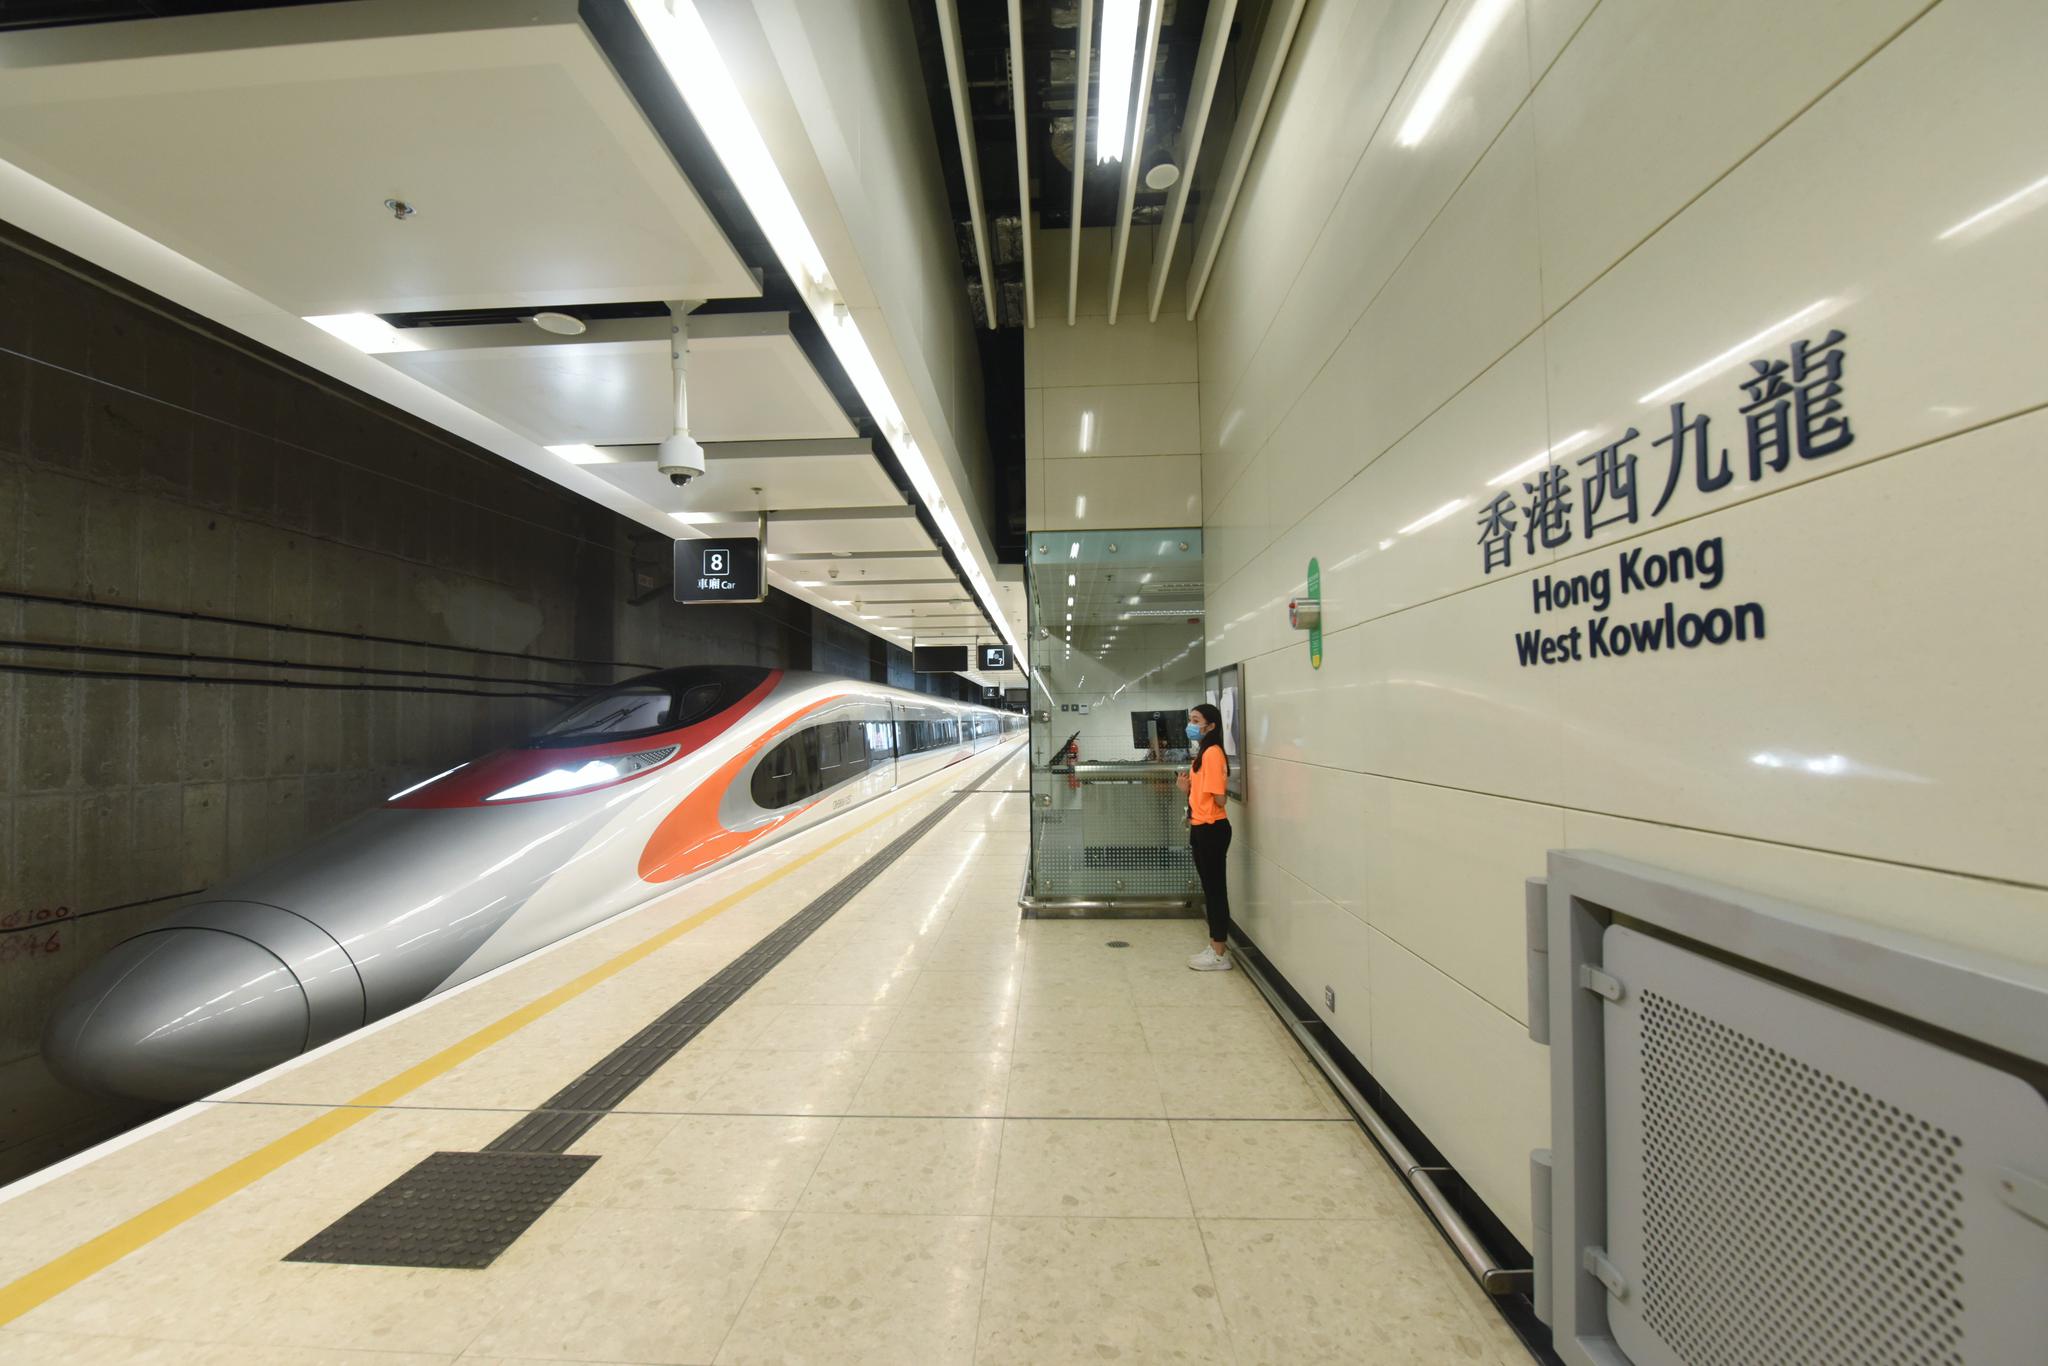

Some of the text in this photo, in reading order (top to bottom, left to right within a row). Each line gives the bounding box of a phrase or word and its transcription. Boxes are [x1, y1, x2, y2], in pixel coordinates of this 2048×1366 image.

[1477, 329, 1855, 574] 香港西九龍
[711, 554, 723, 571] 8
[721, 581, 736, 590] Car
[1532, 536, 1725, 614] Hong Kong
[1515, 602, 1765, 667] West Kowloon
